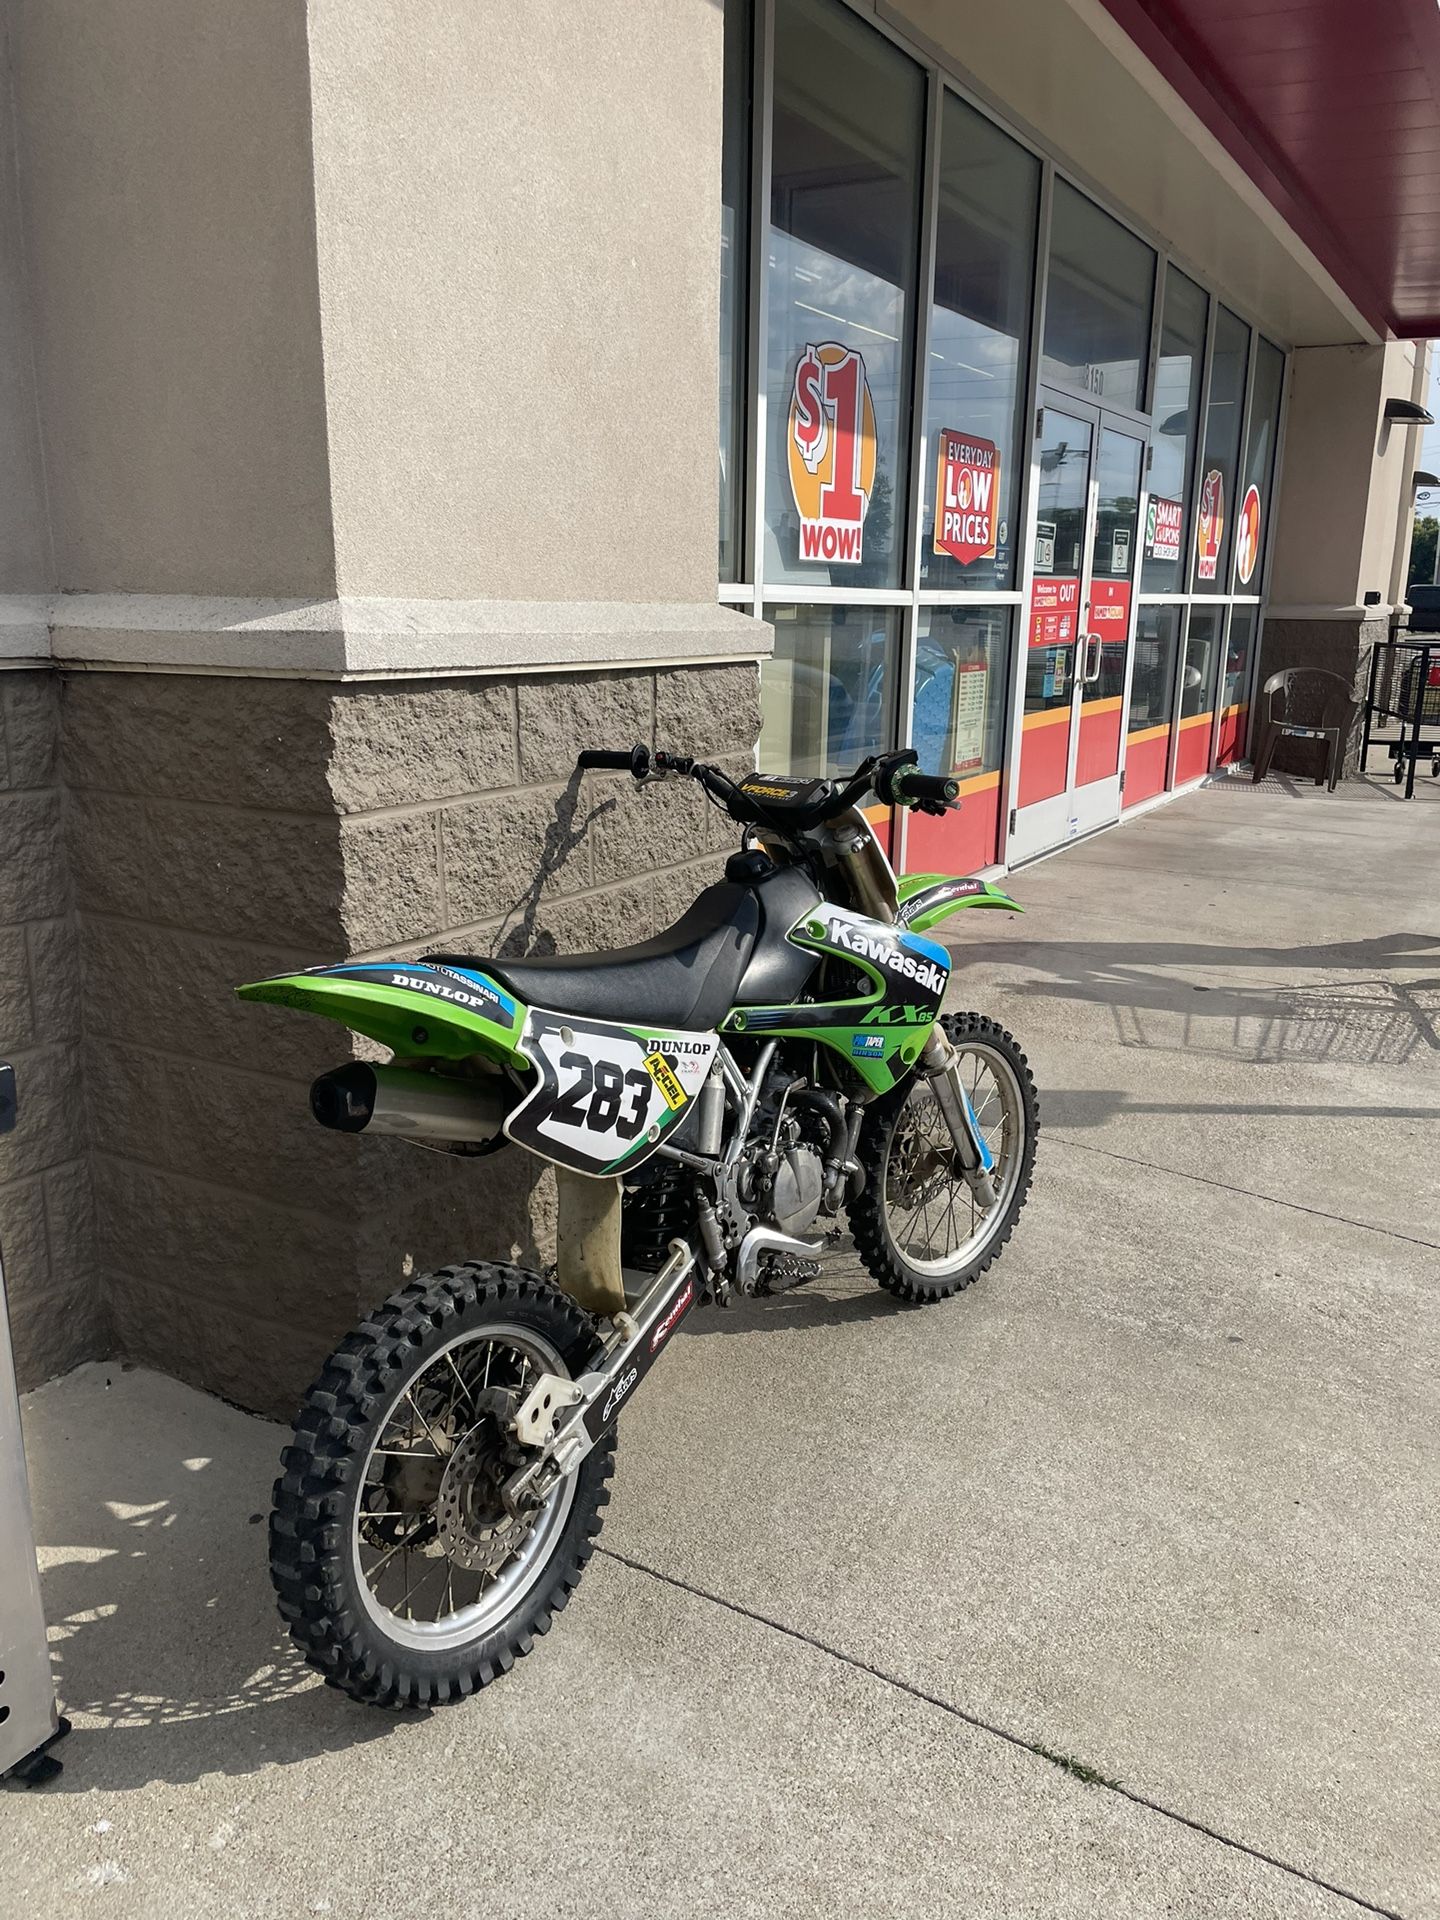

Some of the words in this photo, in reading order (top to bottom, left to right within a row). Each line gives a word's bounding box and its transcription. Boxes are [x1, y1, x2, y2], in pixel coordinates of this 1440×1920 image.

[793, 350, 864, 522] $1
[947, 441, 995, 469] EVERYDAY
[945, 463, 993, 514] LOW
[943, 510, 990, 546] PRICES
[1156, 501, 1182, 528] SMART
[802, 523, 861, 561] WOW!
[1059, 584, 1076, 602] OUT
[830, 918, 947, 996] Kawasaki
[391, 973, 484, 1008] DUNLOP
[648, 1039, 711, 1056] DUNLOP
[548, 1051, 654, 1140] 283
[649, 1057, 681, 1105] ACCEL
